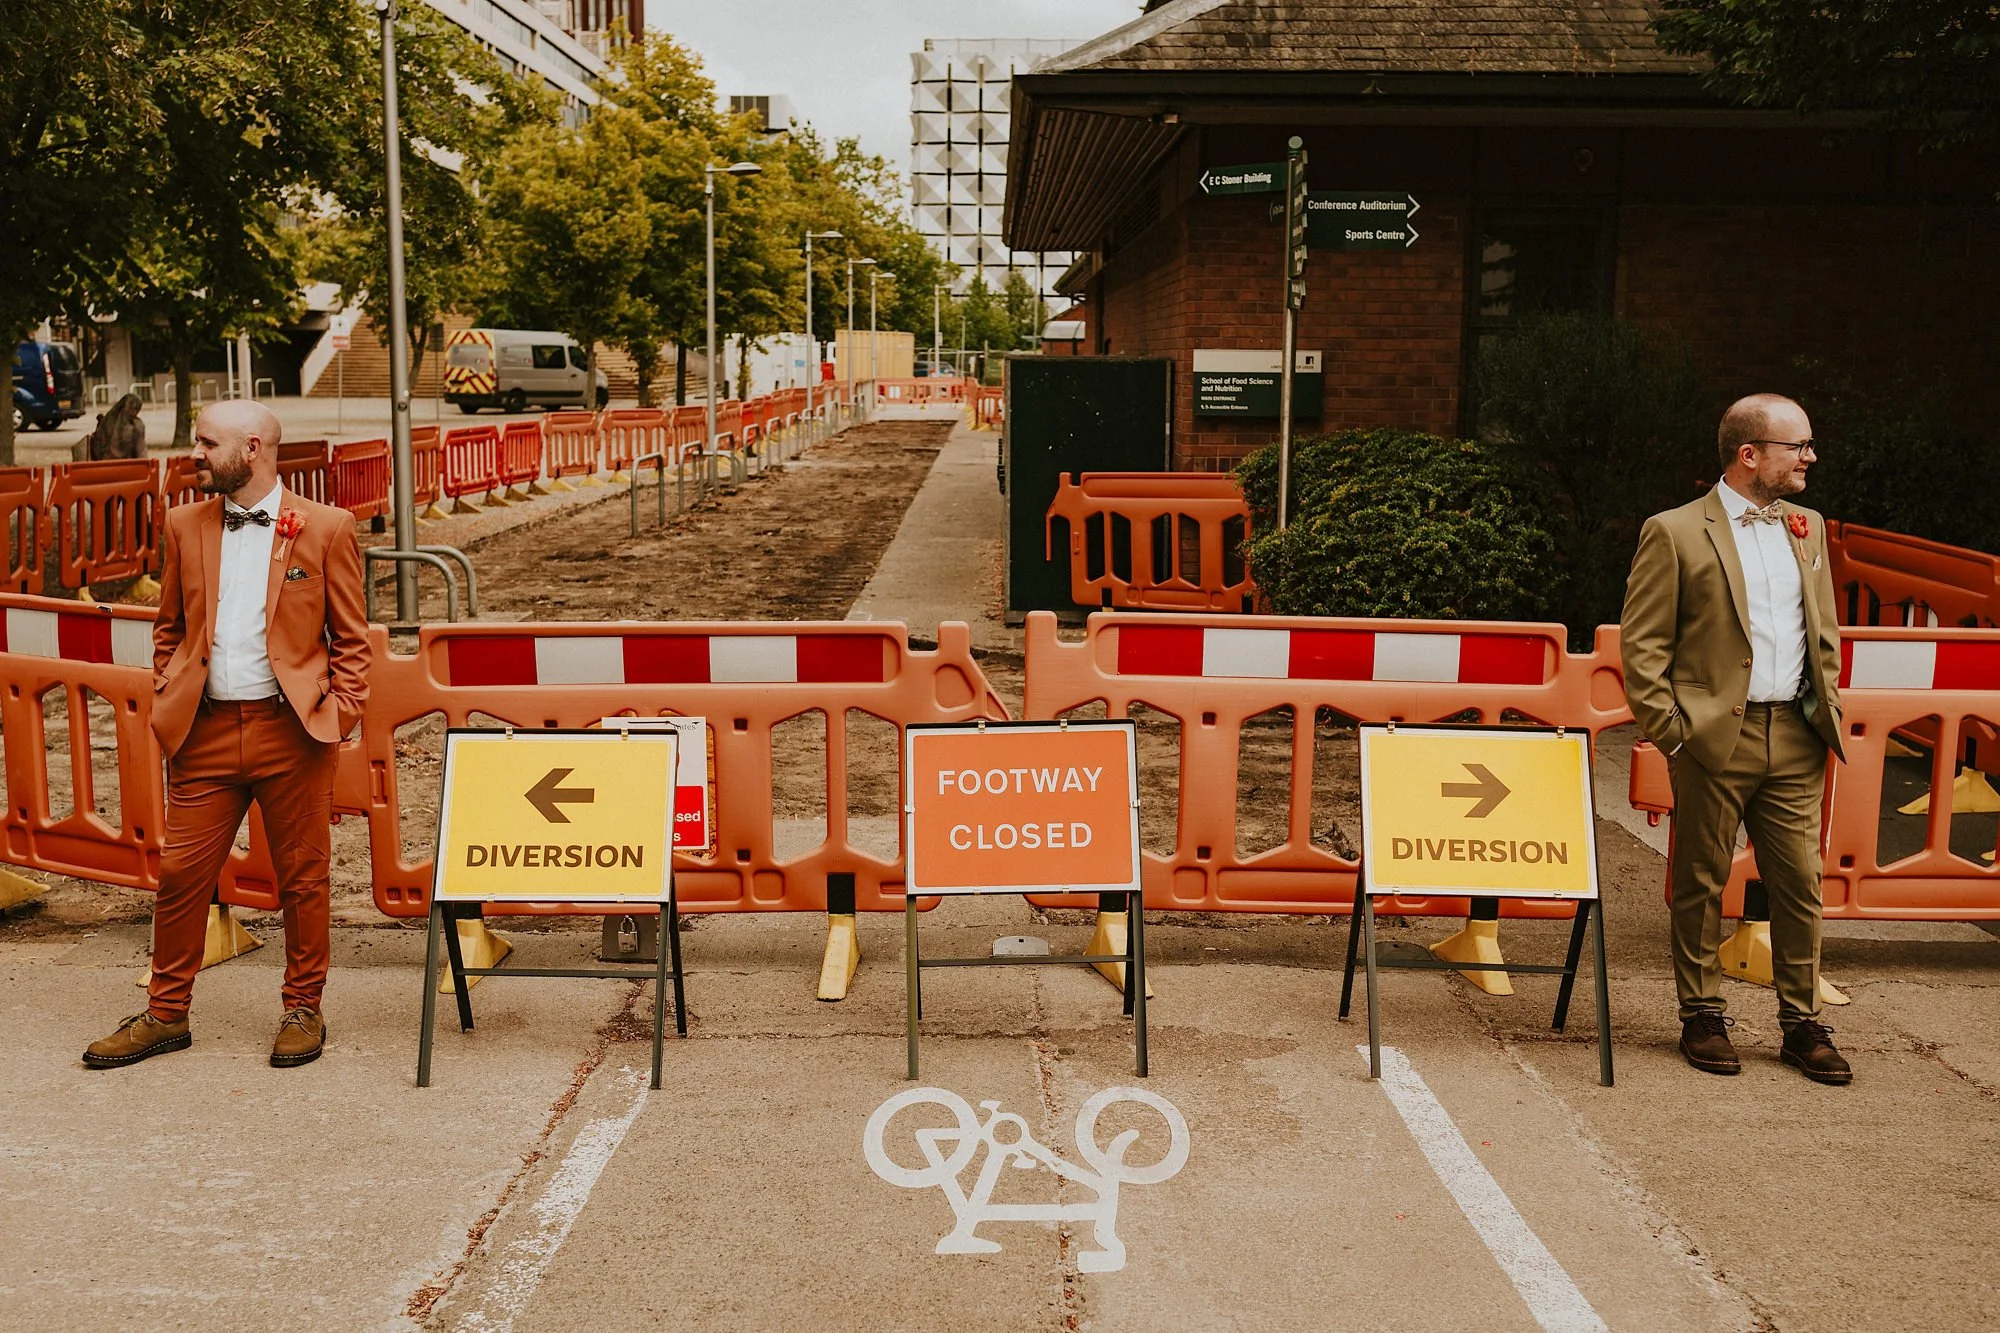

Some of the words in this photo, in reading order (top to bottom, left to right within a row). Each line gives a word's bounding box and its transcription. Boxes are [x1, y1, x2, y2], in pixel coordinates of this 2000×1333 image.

[1209, 176, 1214, 186] E
[1215, 175, 1221, 185] C
[1221, 175, 1243, 185] Stoner
[1244, 172, 1272, 184] Building
[1307, 200, 1358, 210] Conference
[1359, 200, 1407, 211] Auditorium
[1345, 229, 1374, 241] Sports
[1375, 230, 1406, 240] Centre
[1201, 377, 1222, 385] School
[1224, 377, 1230, 385] of
[1232, 377, 1247, 385] Food
[1249, 377, 1274, 385] Science
[938, 766, 1103, 795] FOOTWAY
[949, 822, 1092, 850] CLOSED
[466, 844, 644, 868] DIVERSION
[1391, 837, 1568, 865] DIVERSION
